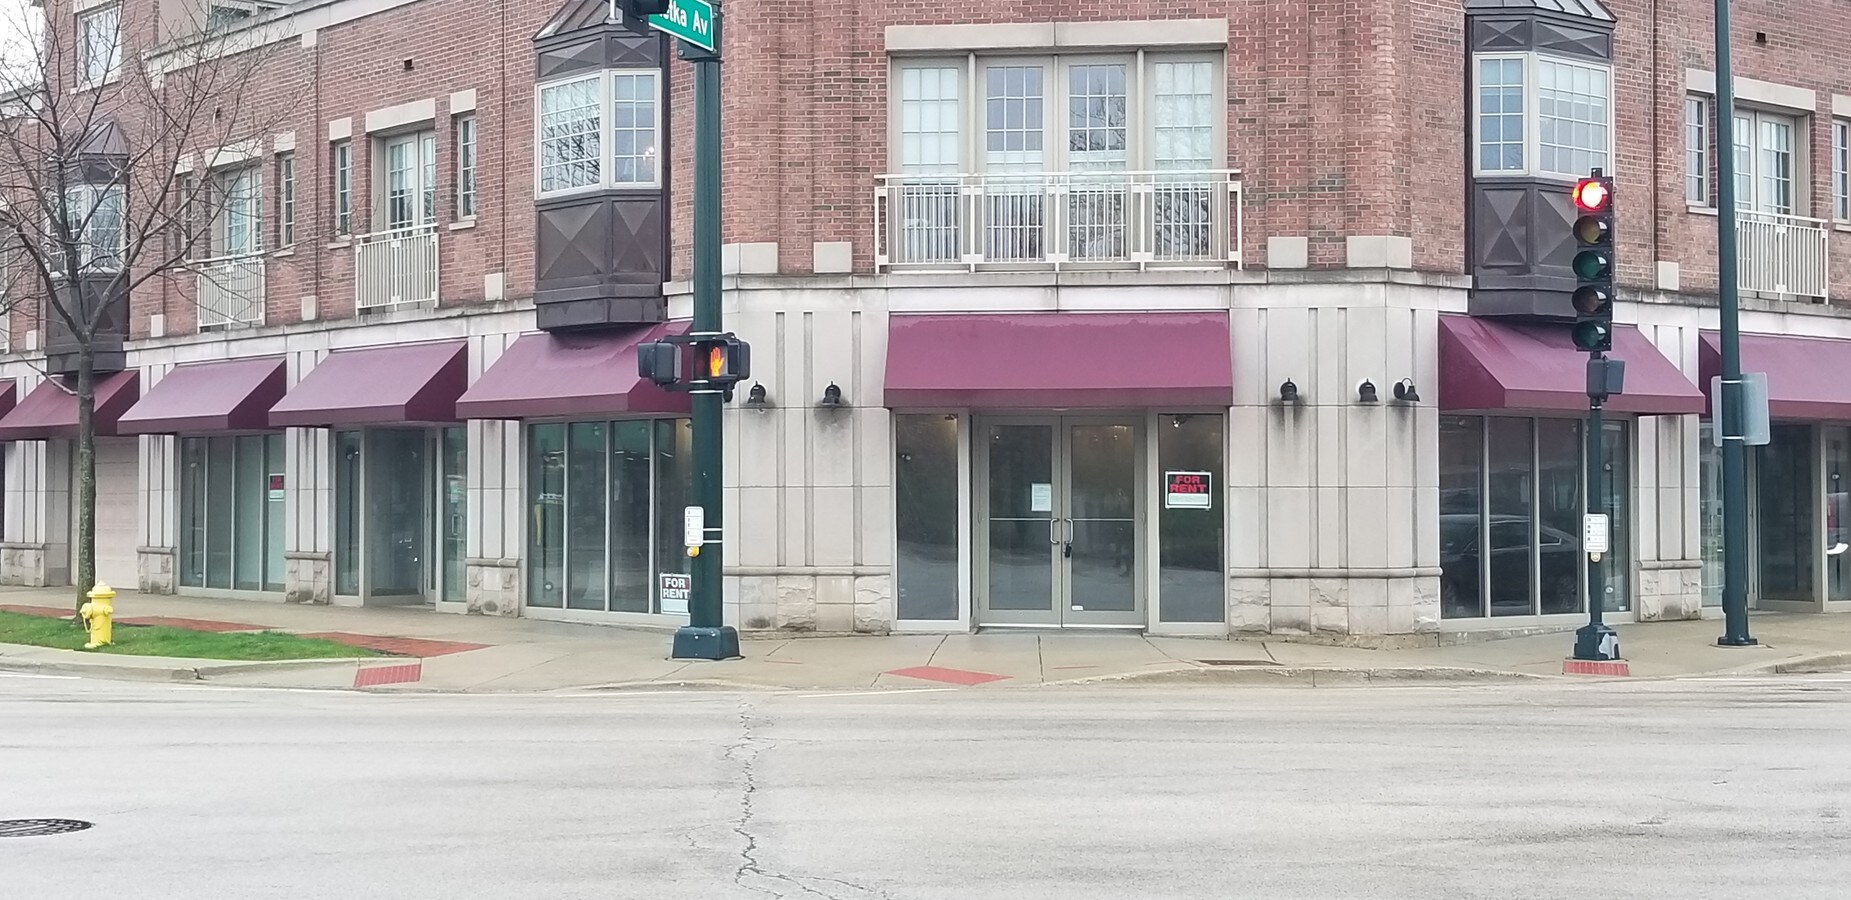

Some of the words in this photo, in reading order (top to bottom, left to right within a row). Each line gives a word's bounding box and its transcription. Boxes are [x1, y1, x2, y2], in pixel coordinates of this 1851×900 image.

[693, 10, 708, 36] Av
[1175, 475, 1200, 484] FOR
[1169, 484, 1207, 493] RENT
[664, 577, 686, 588] FOR
[662, 588, 690, 599] RENT
